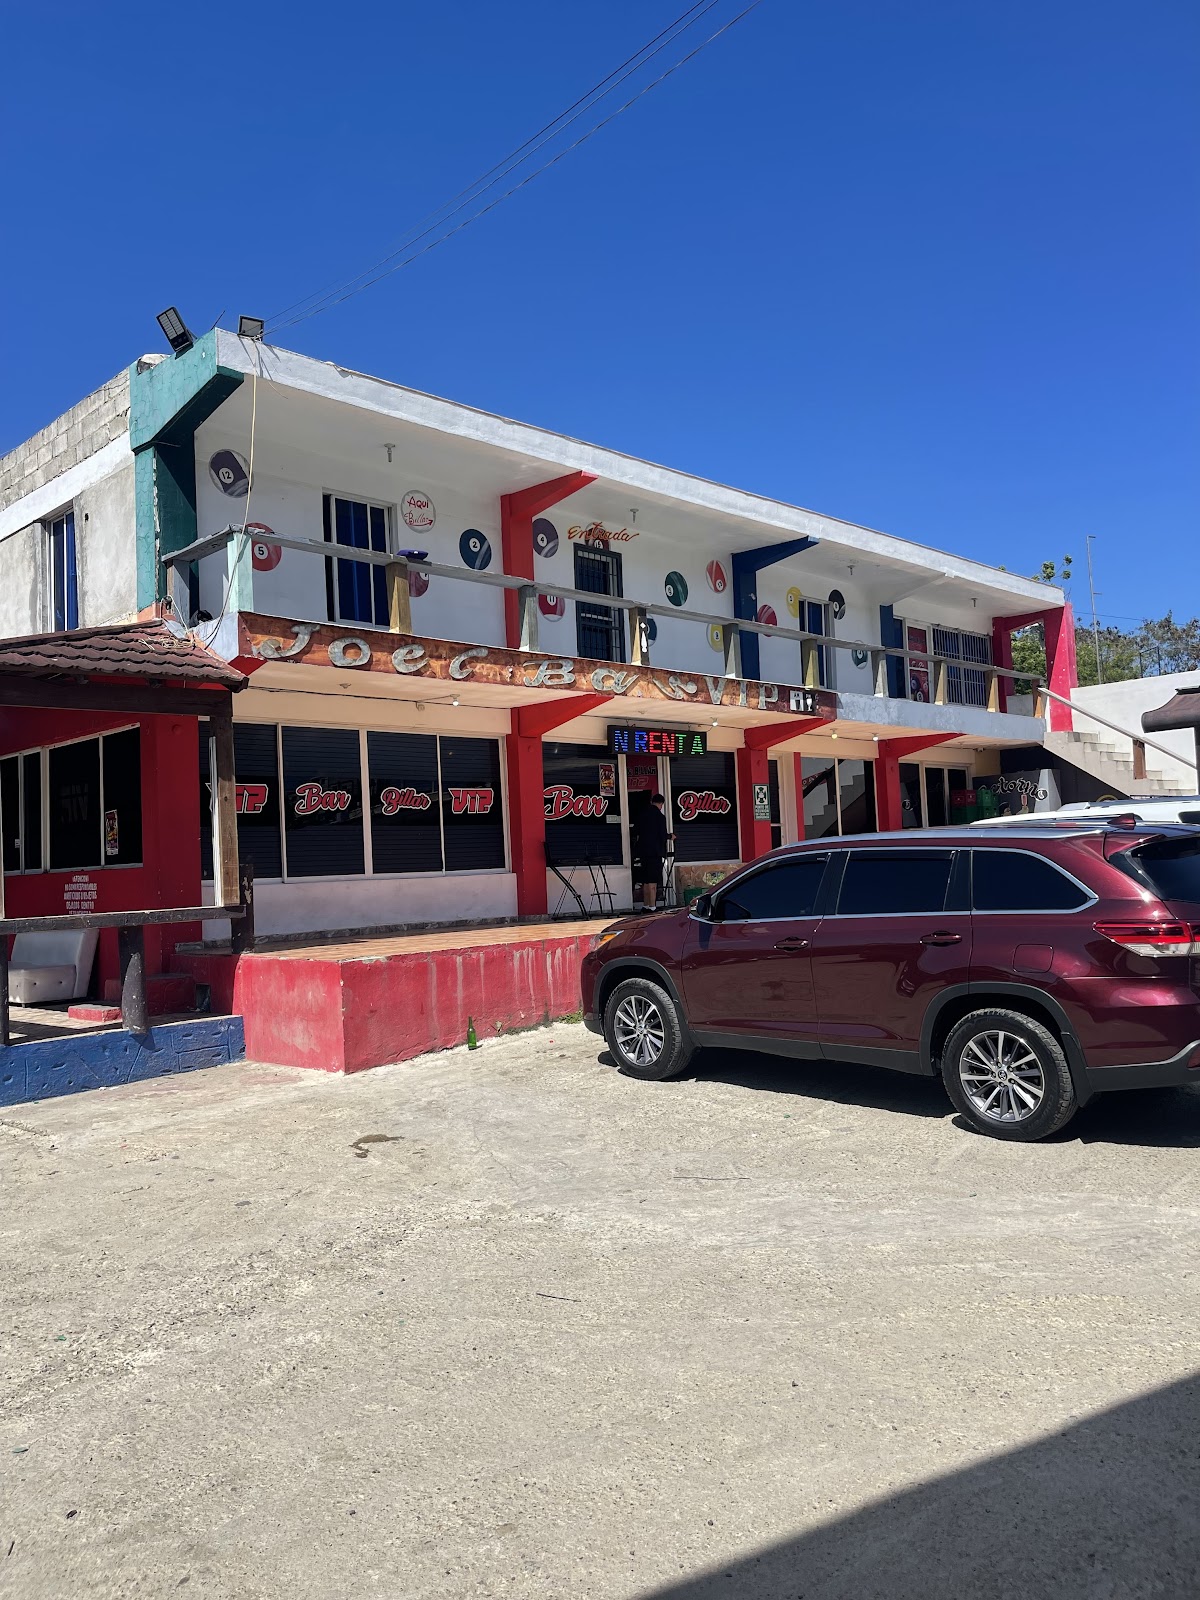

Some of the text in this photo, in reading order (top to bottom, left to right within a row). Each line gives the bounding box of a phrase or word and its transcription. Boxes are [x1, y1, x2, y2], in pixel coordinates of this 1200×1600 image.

[221, 471, 232, 480] 12
[472, 541, 478, 549] 2
[567, 521, 640, 542] Entrada
[258, 546, 265, 556] 5
[703, 675, 779, 710] VIP
[634, 731, 705, 755] RENTA
[205, 783, 269, 814] IP
[294, 782, 351, 815] Bar
[380, 786, 432, 816] Billar
[447, 787, 494, 814] VIP
[542, 784, 609, 821] Bar
[677, 790, 731, 821] Billar
